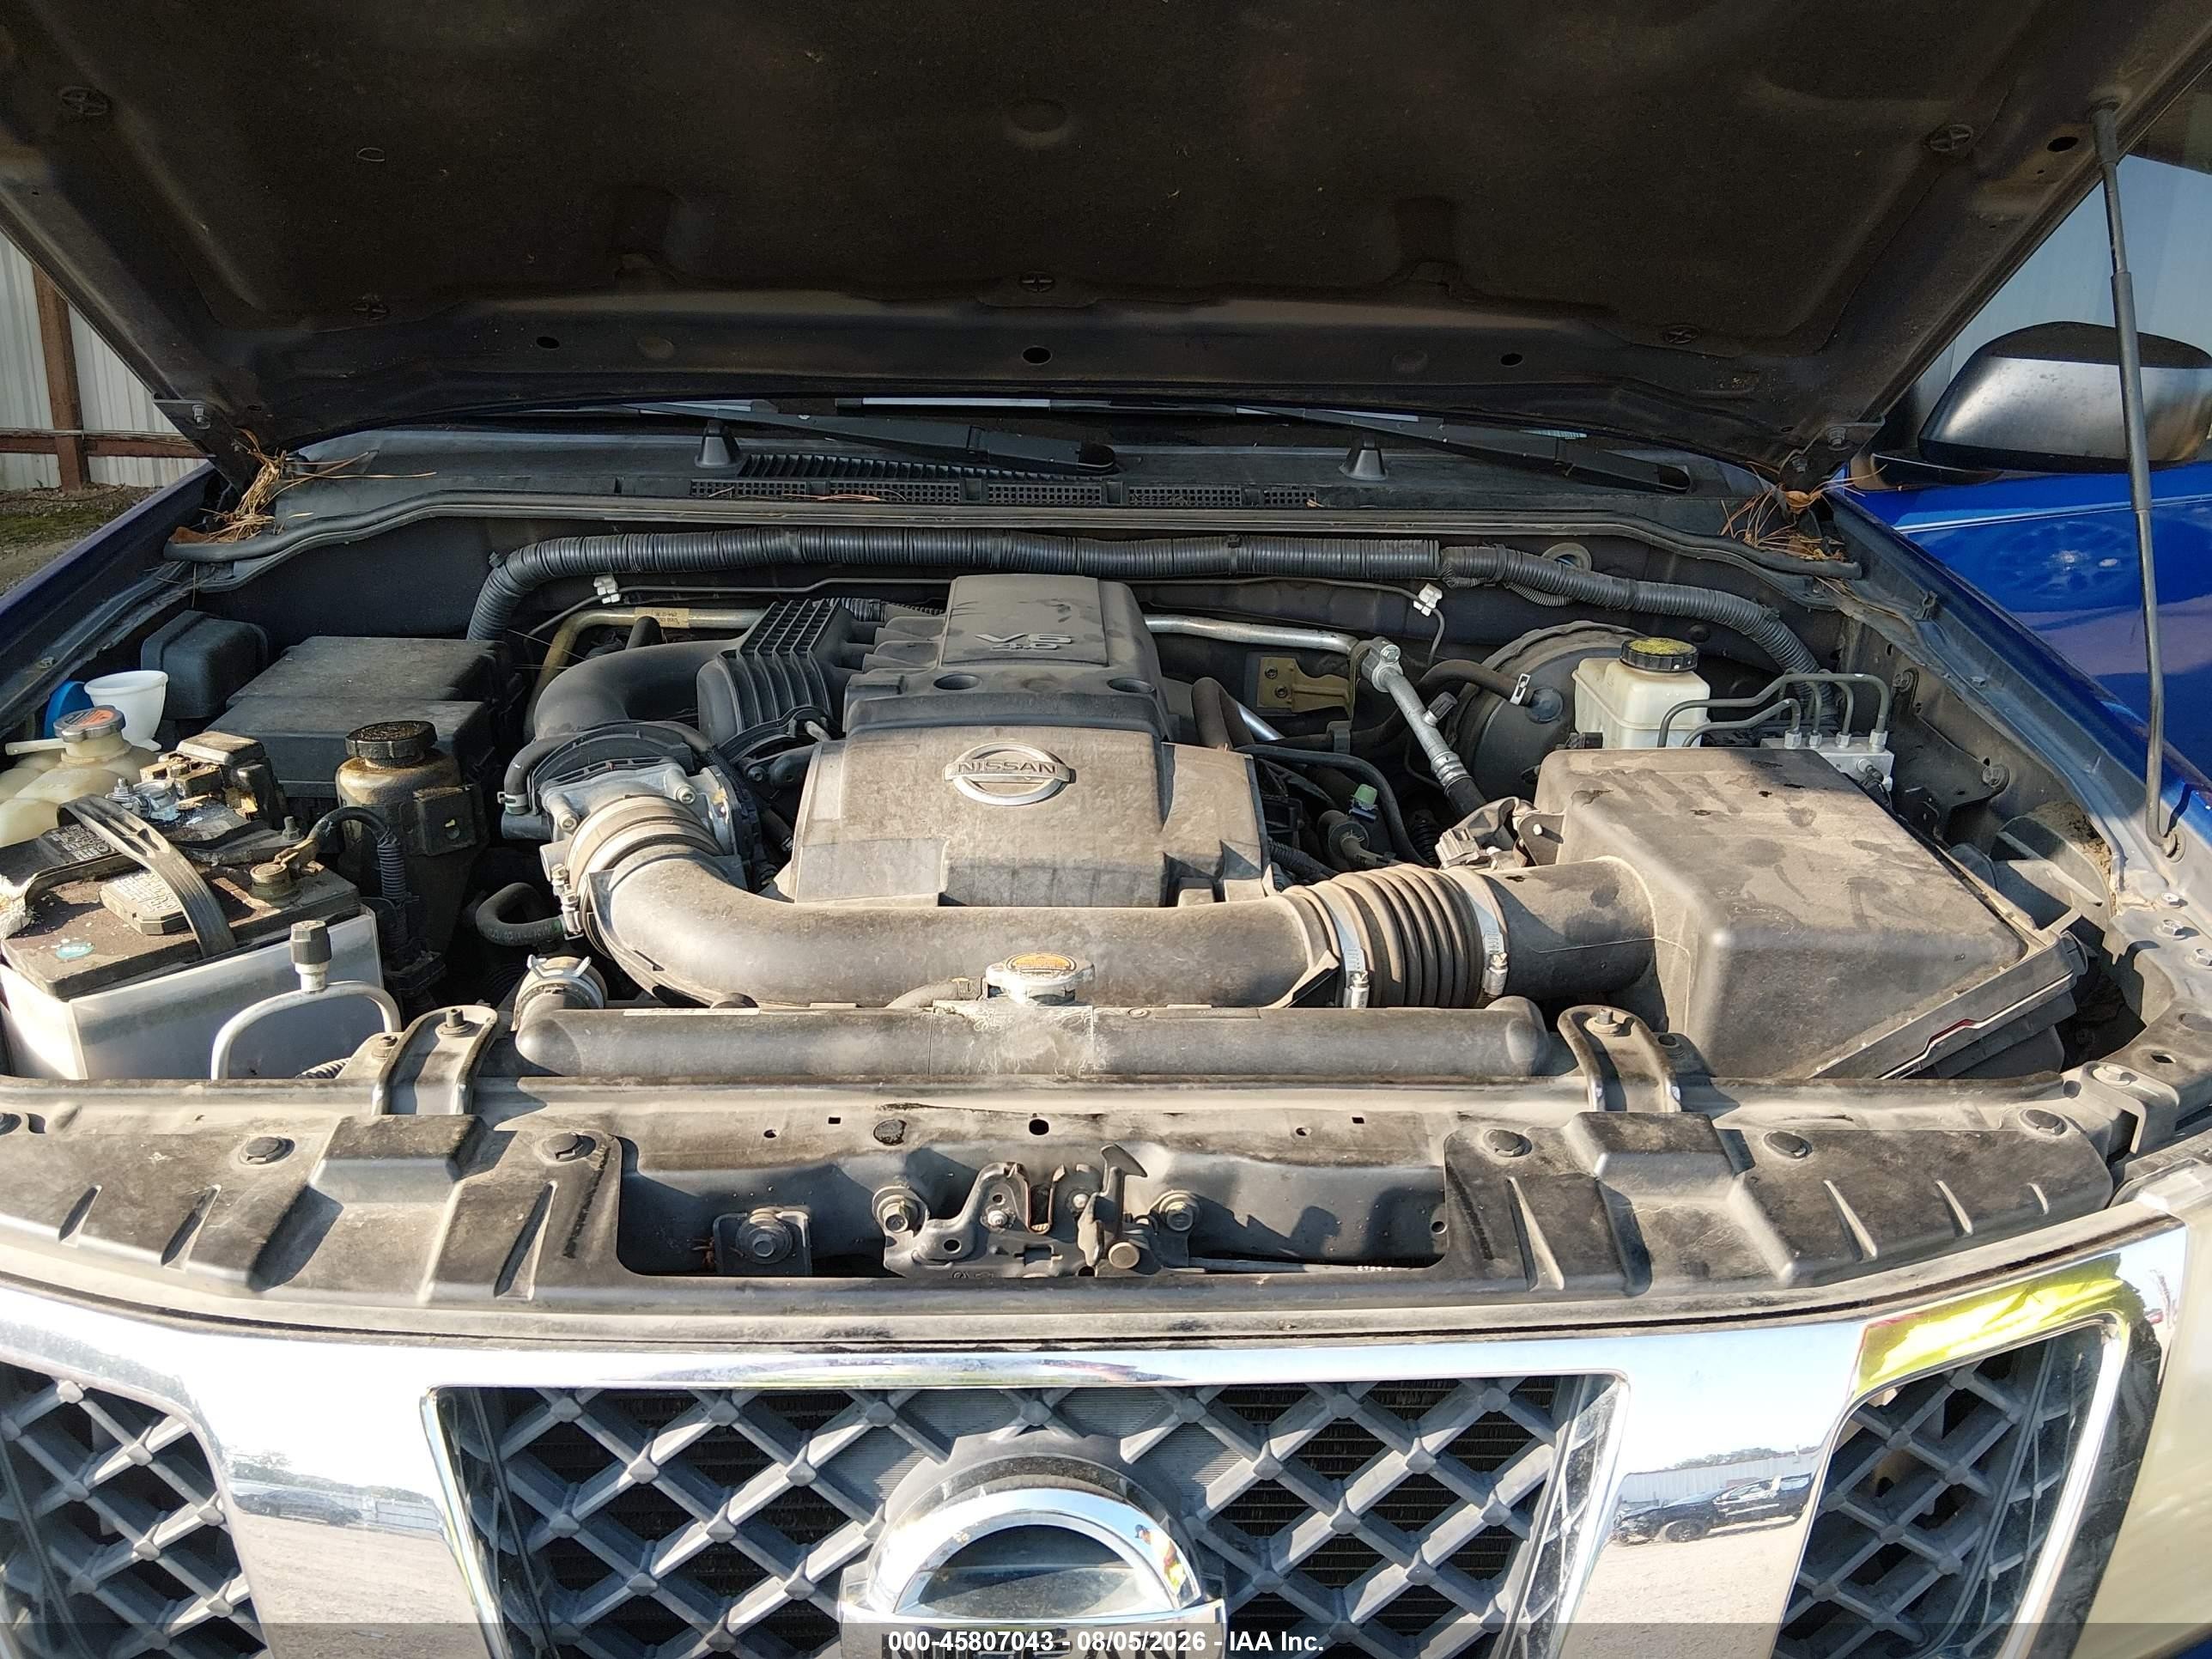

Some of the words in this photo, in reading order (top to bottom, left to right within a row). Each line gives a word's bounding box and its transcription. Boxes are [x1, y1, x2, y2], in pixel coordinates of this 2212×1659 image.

[975, 633, 1073, 644] V6
[991, 642, 1058, 651] 4.0
[957, 761, 1058, 774] NISSAN
